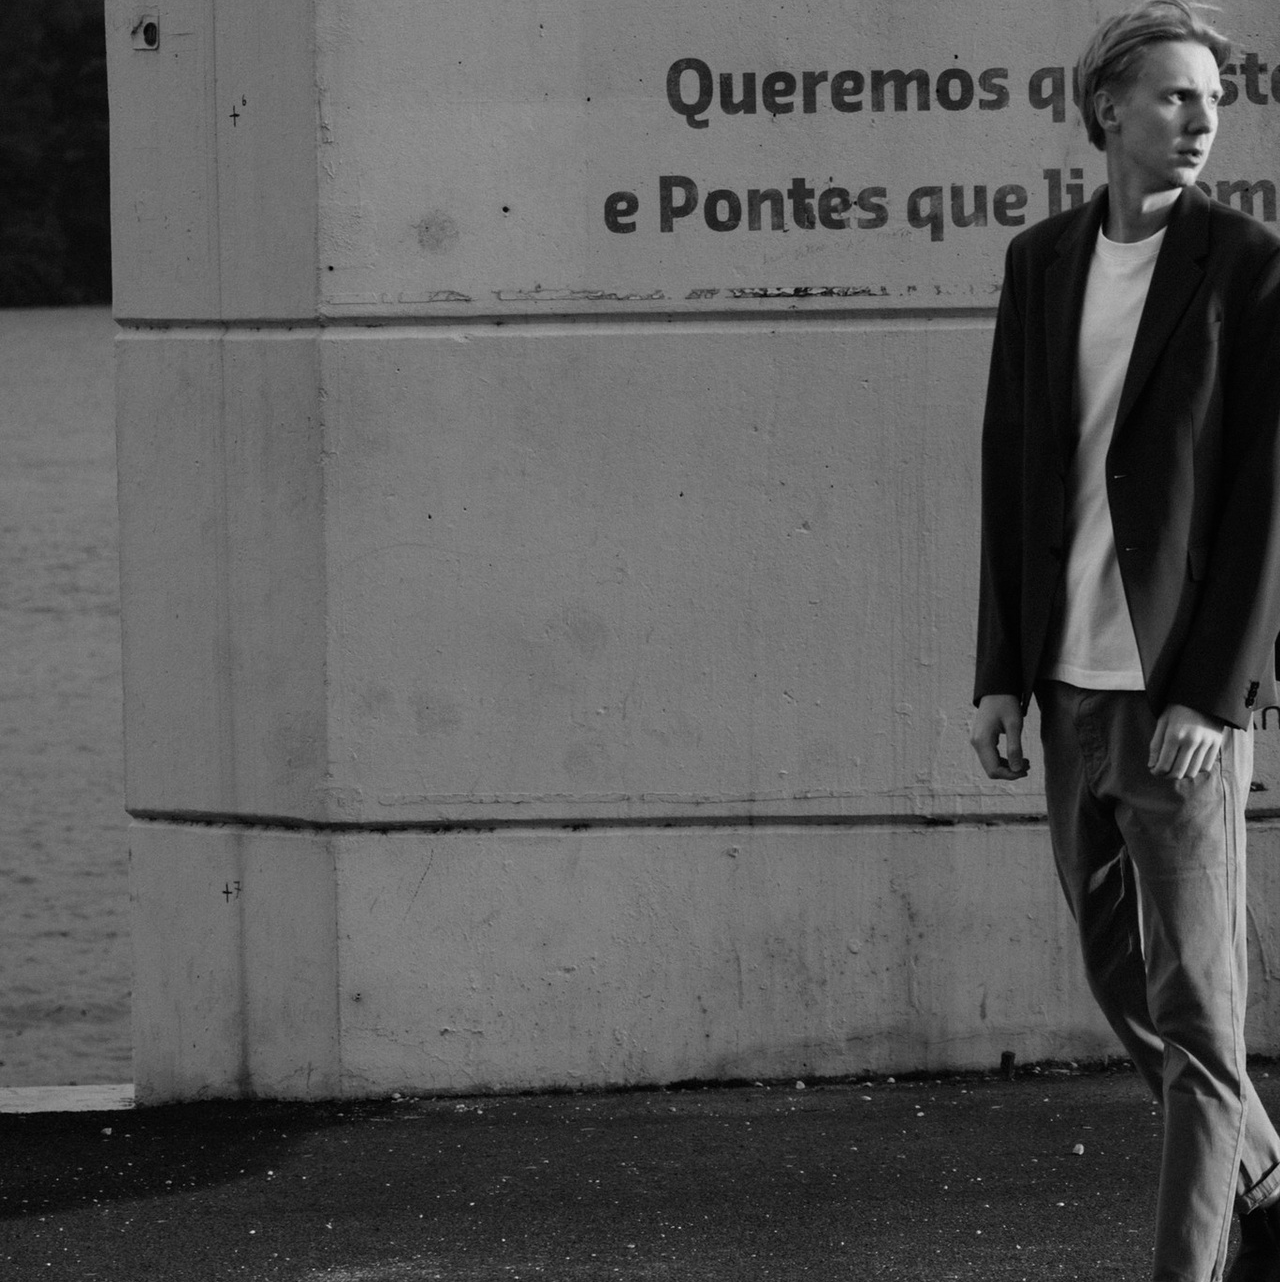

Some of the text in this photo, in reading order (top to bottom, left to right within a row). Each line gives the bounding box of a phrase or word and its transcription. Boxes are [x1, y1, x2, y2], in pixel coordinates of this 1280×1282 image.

[666, 57, 1009, 130] Queremos
[604, 190, 639, 234] e
[659, 175, 889, 234] Pontes
[906, 183, 1027, 242] que
